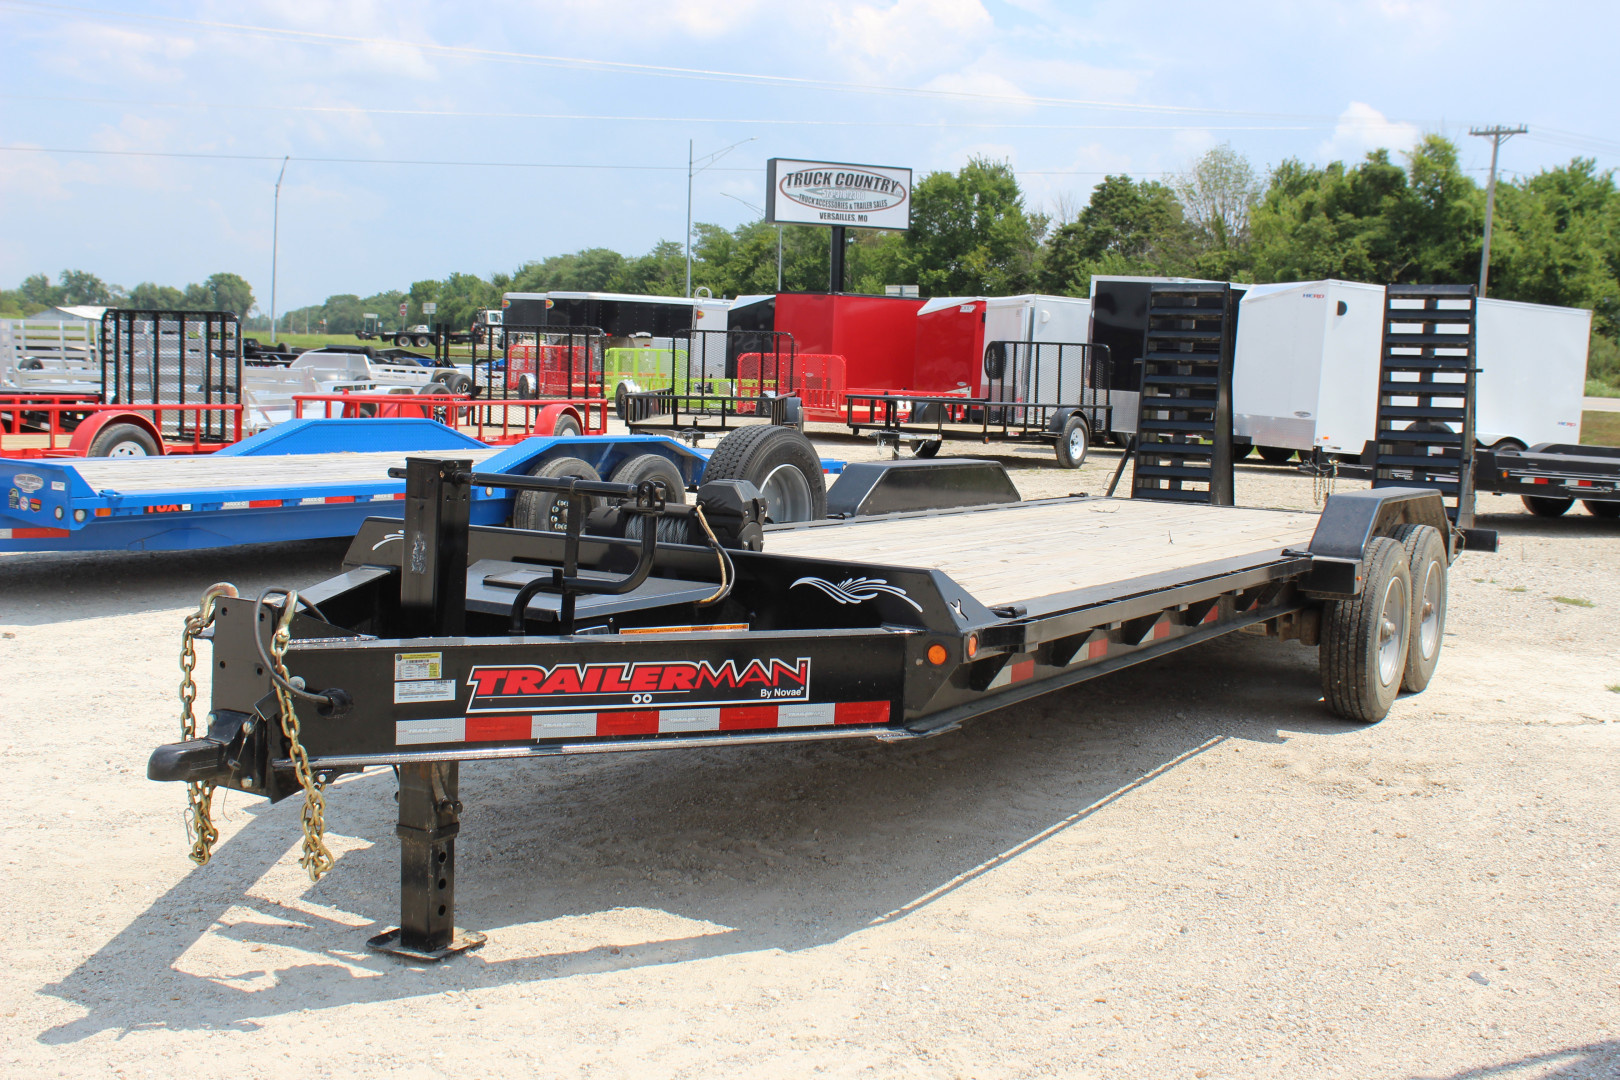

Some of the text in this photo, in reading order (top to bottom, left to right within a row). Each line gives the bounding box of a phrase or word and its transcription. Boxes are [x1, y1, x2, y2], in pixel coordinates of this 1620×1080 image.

[786, 171, 833, 188] TRUCK
[835, 172, 900, 193] COUNTRY
[798, 193, 816, 206] TRUCK
[815, 199, 849, 210] ACCESSORIES
[853, 200, 873, 210] TRAILER
[873, 199, 888, 208] SALES
[819, 212, 868, 223] VERSAILLES, MO
[473, 662, 806, 695] TRAILERMAN
[760, 687, 802, 699] By Novae
